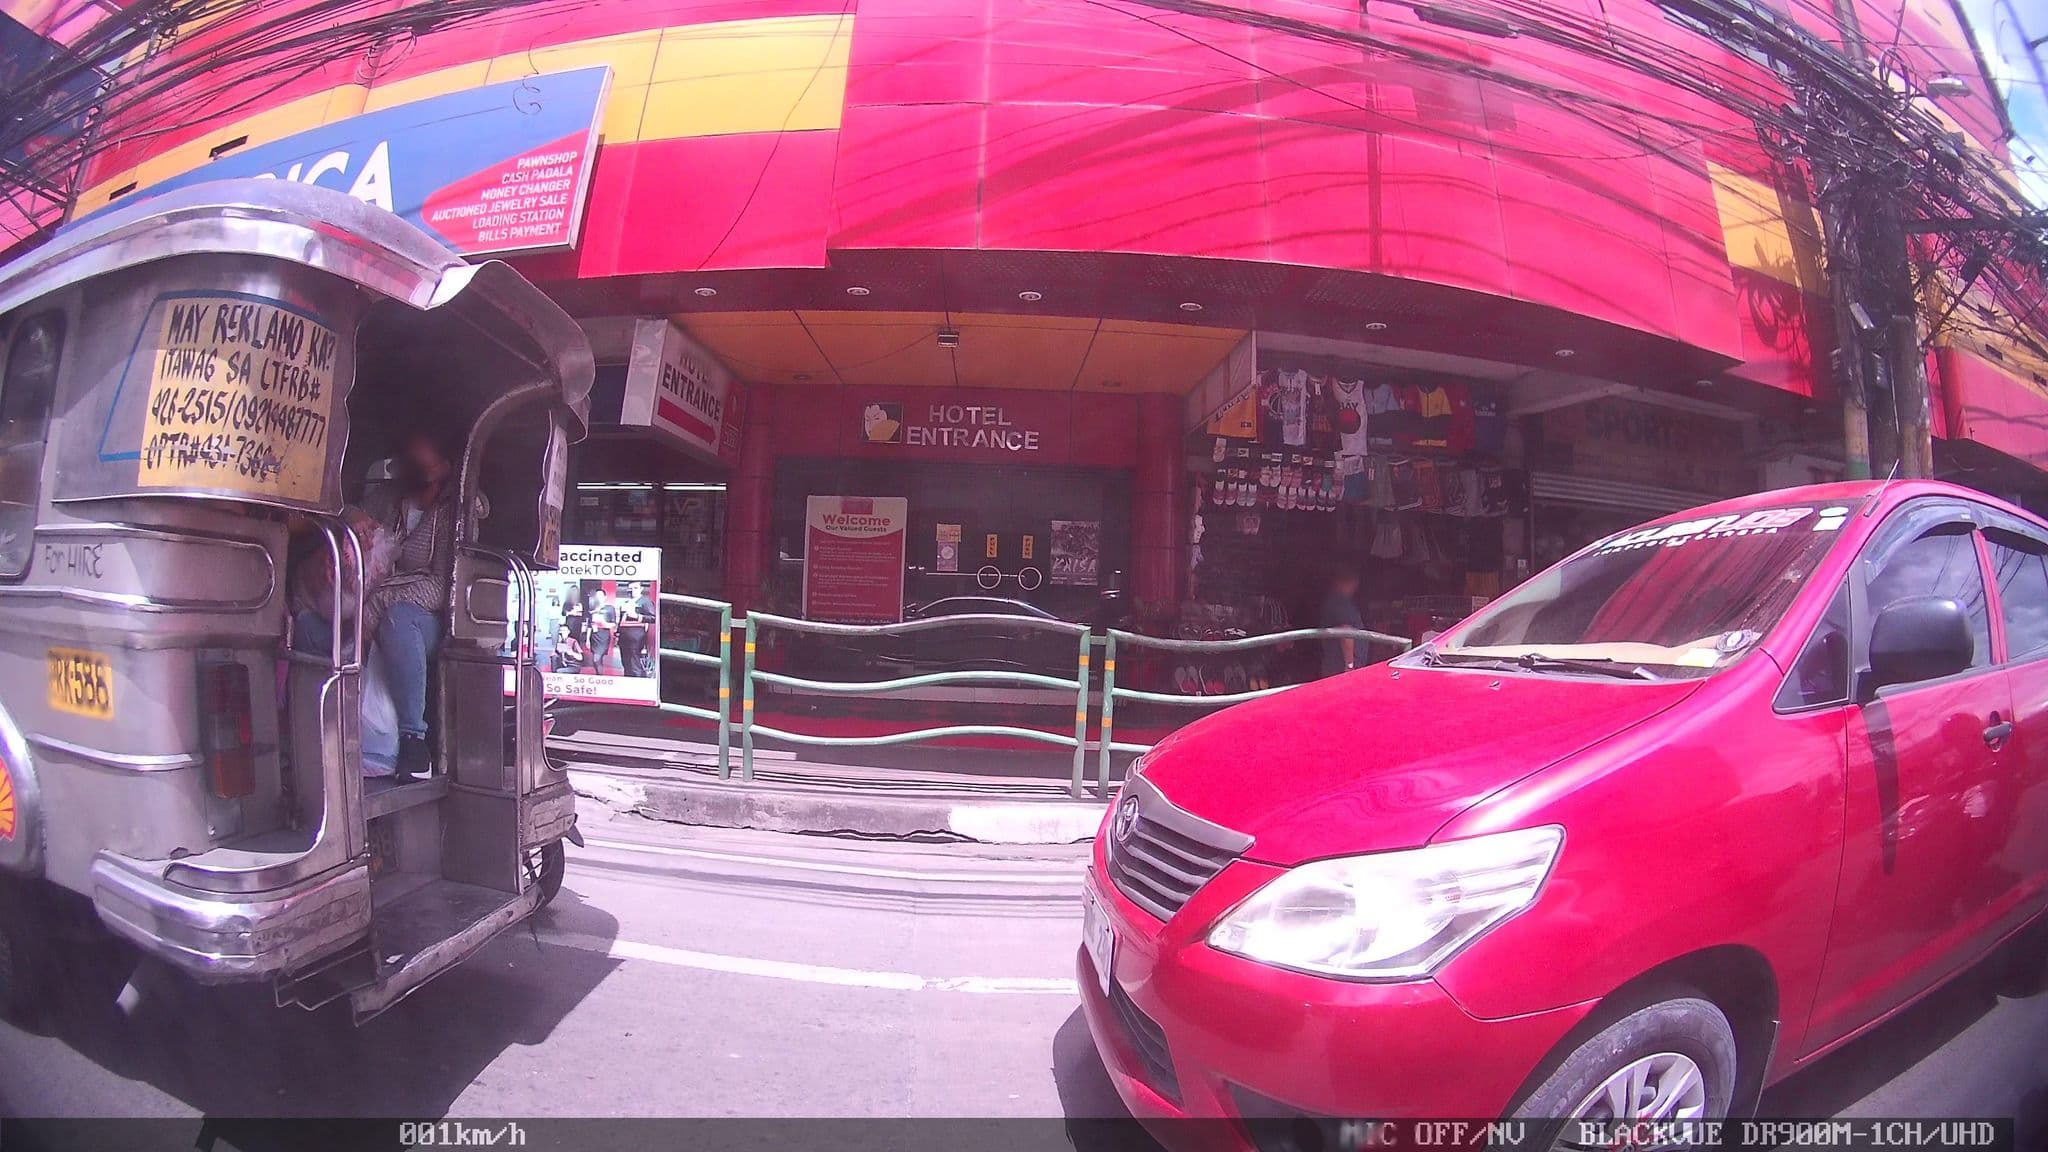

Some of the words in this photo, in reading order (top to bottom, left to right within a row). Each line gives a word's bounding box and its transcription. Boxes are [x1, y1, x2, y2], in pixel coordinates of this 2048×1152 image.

[517, 152, 577, 169] PAWNSHOP
[502, 172, 529, 185] CASH
[530, 166, 573, 181] PADALA
[481, 186, 519, 201] MONEY
[519, 179, 570, 192] CHANGER
[432, 204, 488, 221] AUCTIONED
[488, 196, 539, 213] JEWELRY
[539, 193, 568, 207] SALE
[472, 214, 518, 230] LOADING
[519, 208, 565, 223] STATION
[478, 228, 507, 242] BILLS
[510, 223, 561, 239] PAYMENT
[167, 304, 209, 344] MAY
[212, 303, 304, 361] REKLAMO
[307, 327, 336, 371] KA?
[161, 348, 218, 382] ITAWAG
[226, 351, 250, 385] SA
[261, 357, 321, 401] LTFRB#
[662, 362, 721, 422] ENTRANCE
[929, 404, 1012, 426] HOTEL
[906, 426, 1040, 451] ENTRANCE
[823, 514, 891, 527] Welcome
[840, 525, 863, 533] Valued
[68, 543, 103, 578] HIRE
[560, 549, 642, 563] accinated
[552, 565, 637, 576] otekTODO
[546, 683, 561, 693] So
[565, 684, 597, 695] Safe!
